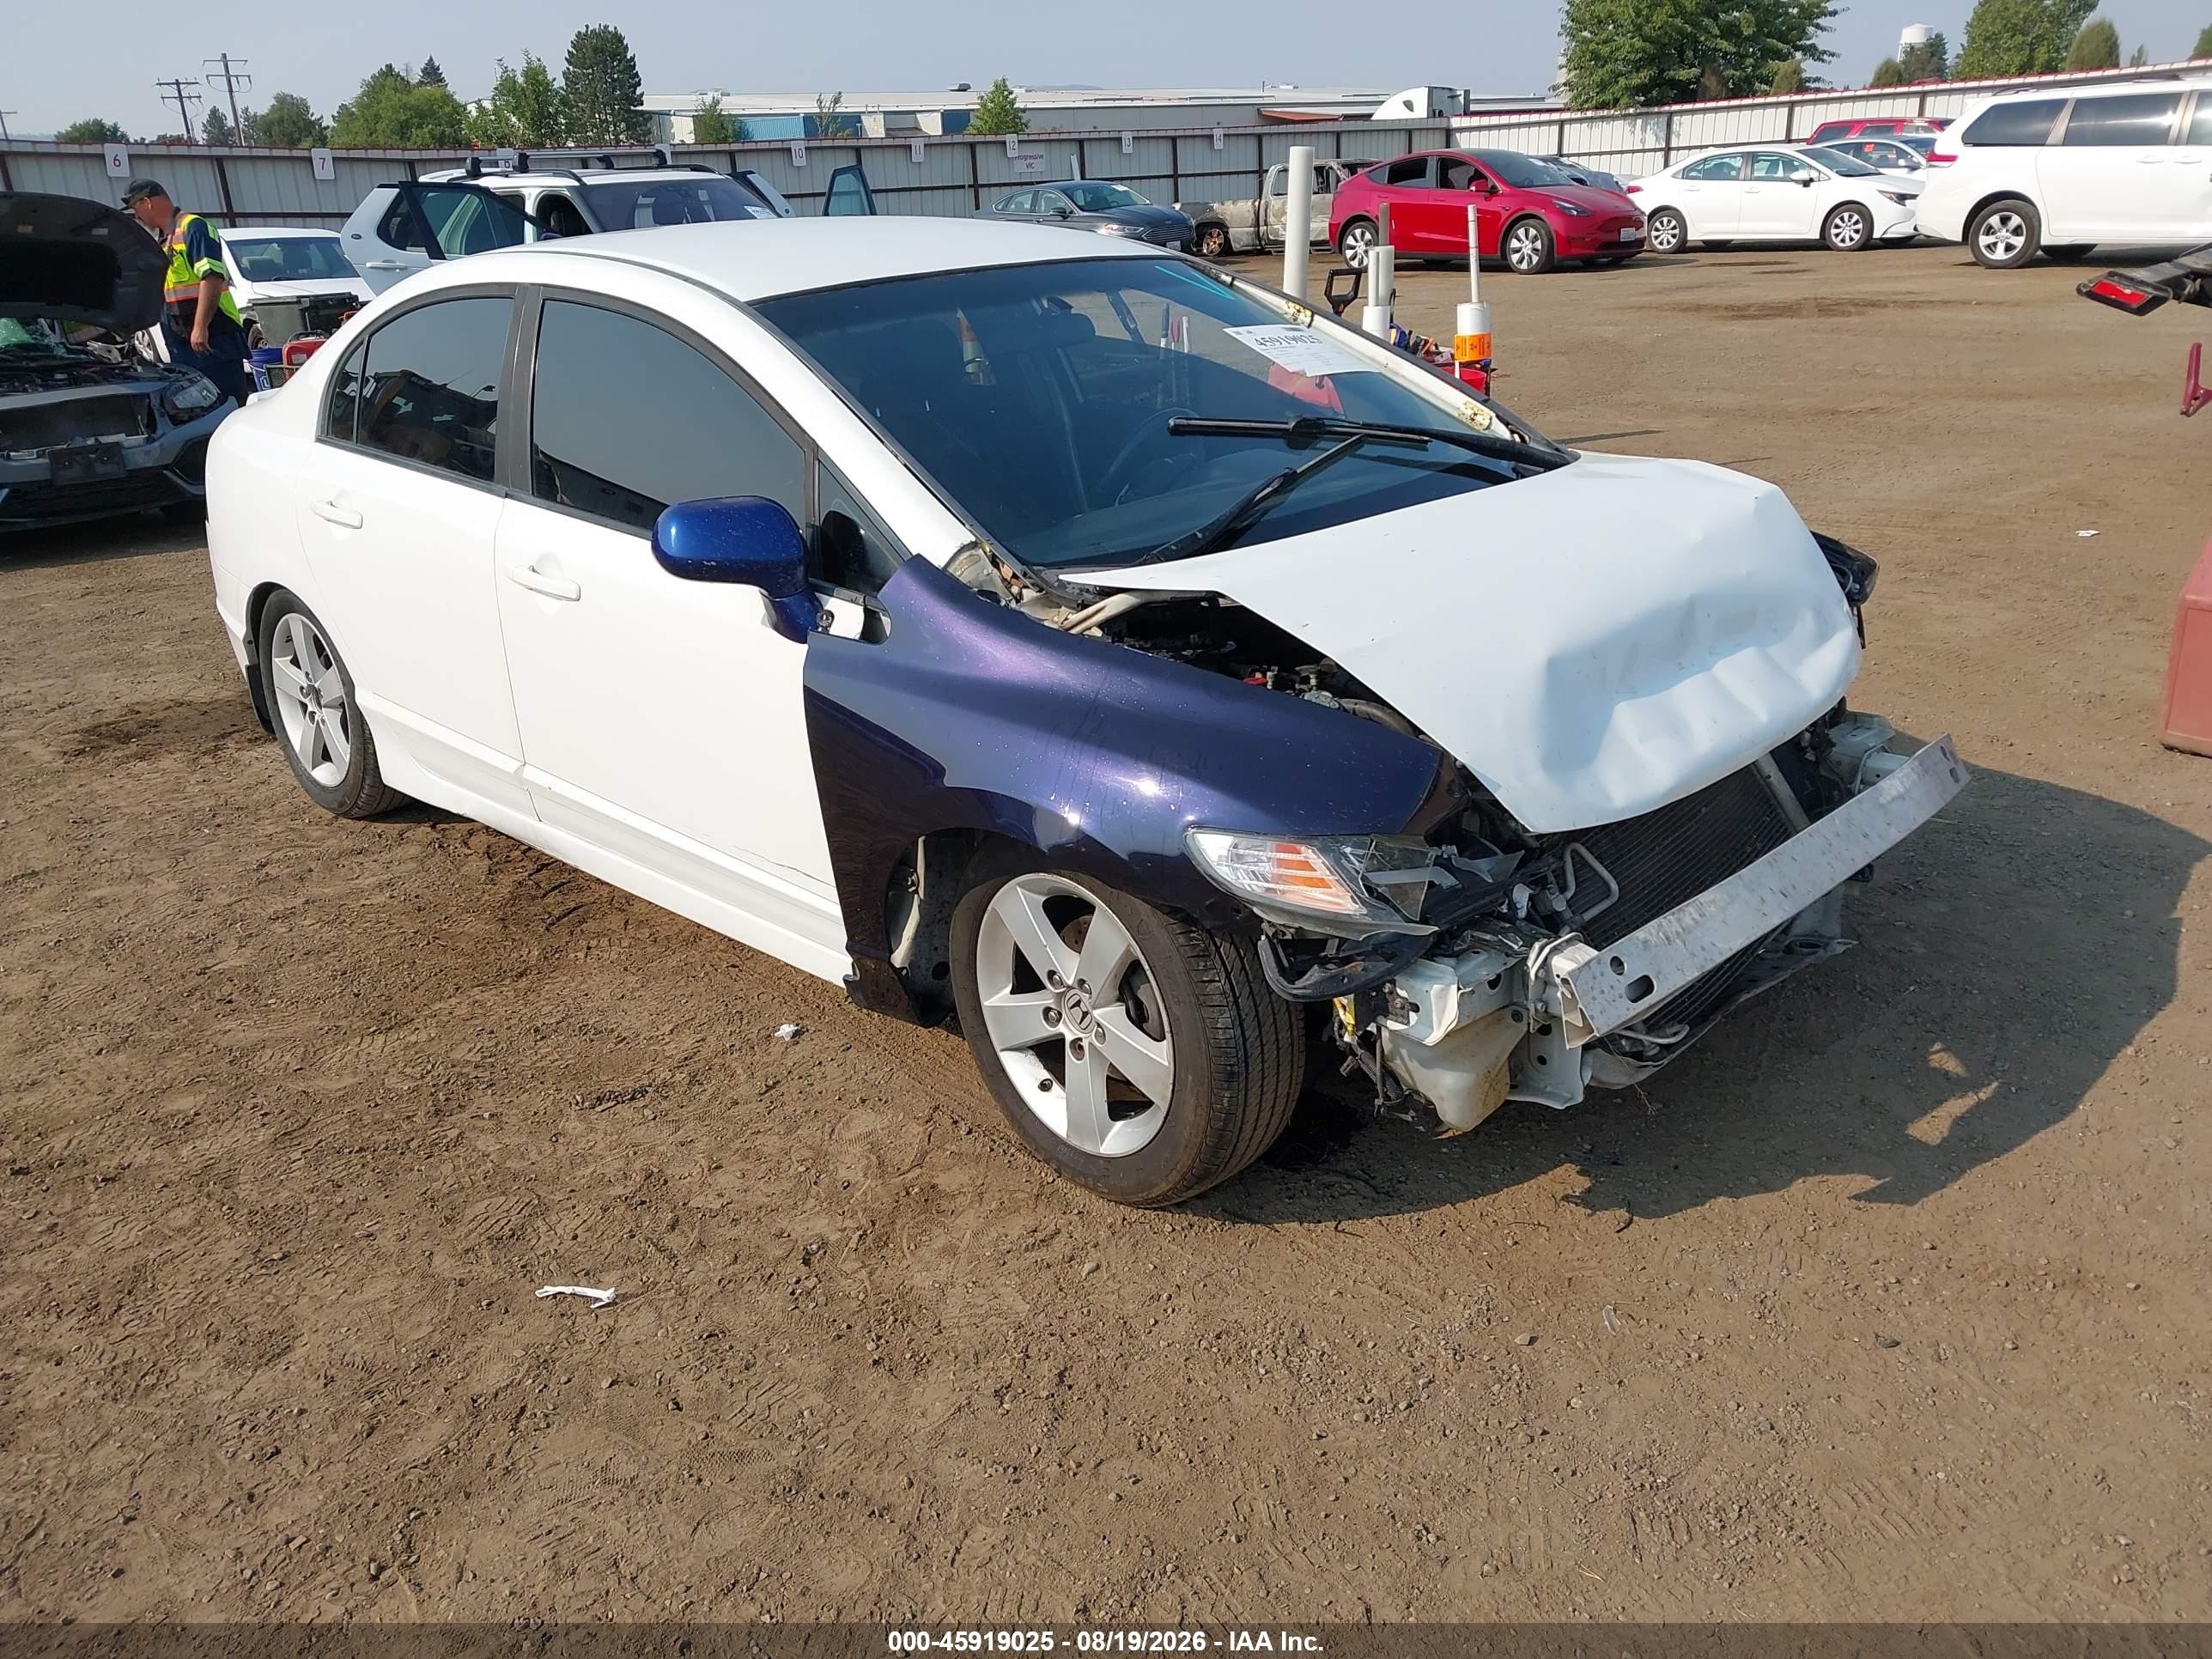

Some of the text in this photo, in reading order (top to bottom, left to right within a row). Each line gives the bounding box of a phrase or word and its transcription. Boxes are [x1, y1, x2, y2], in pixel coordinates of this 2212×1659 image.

[1008, 140, 1017, 150] 12
[1124, 137, 1131, 147] 13
[793, 148, 804, 159] 10
[915, 144, 921, 155] 11
[112, 154, 121, 167] 6
[319, 157, 326, 171] 7
[1254, 334, 1323, 348] 45919025
